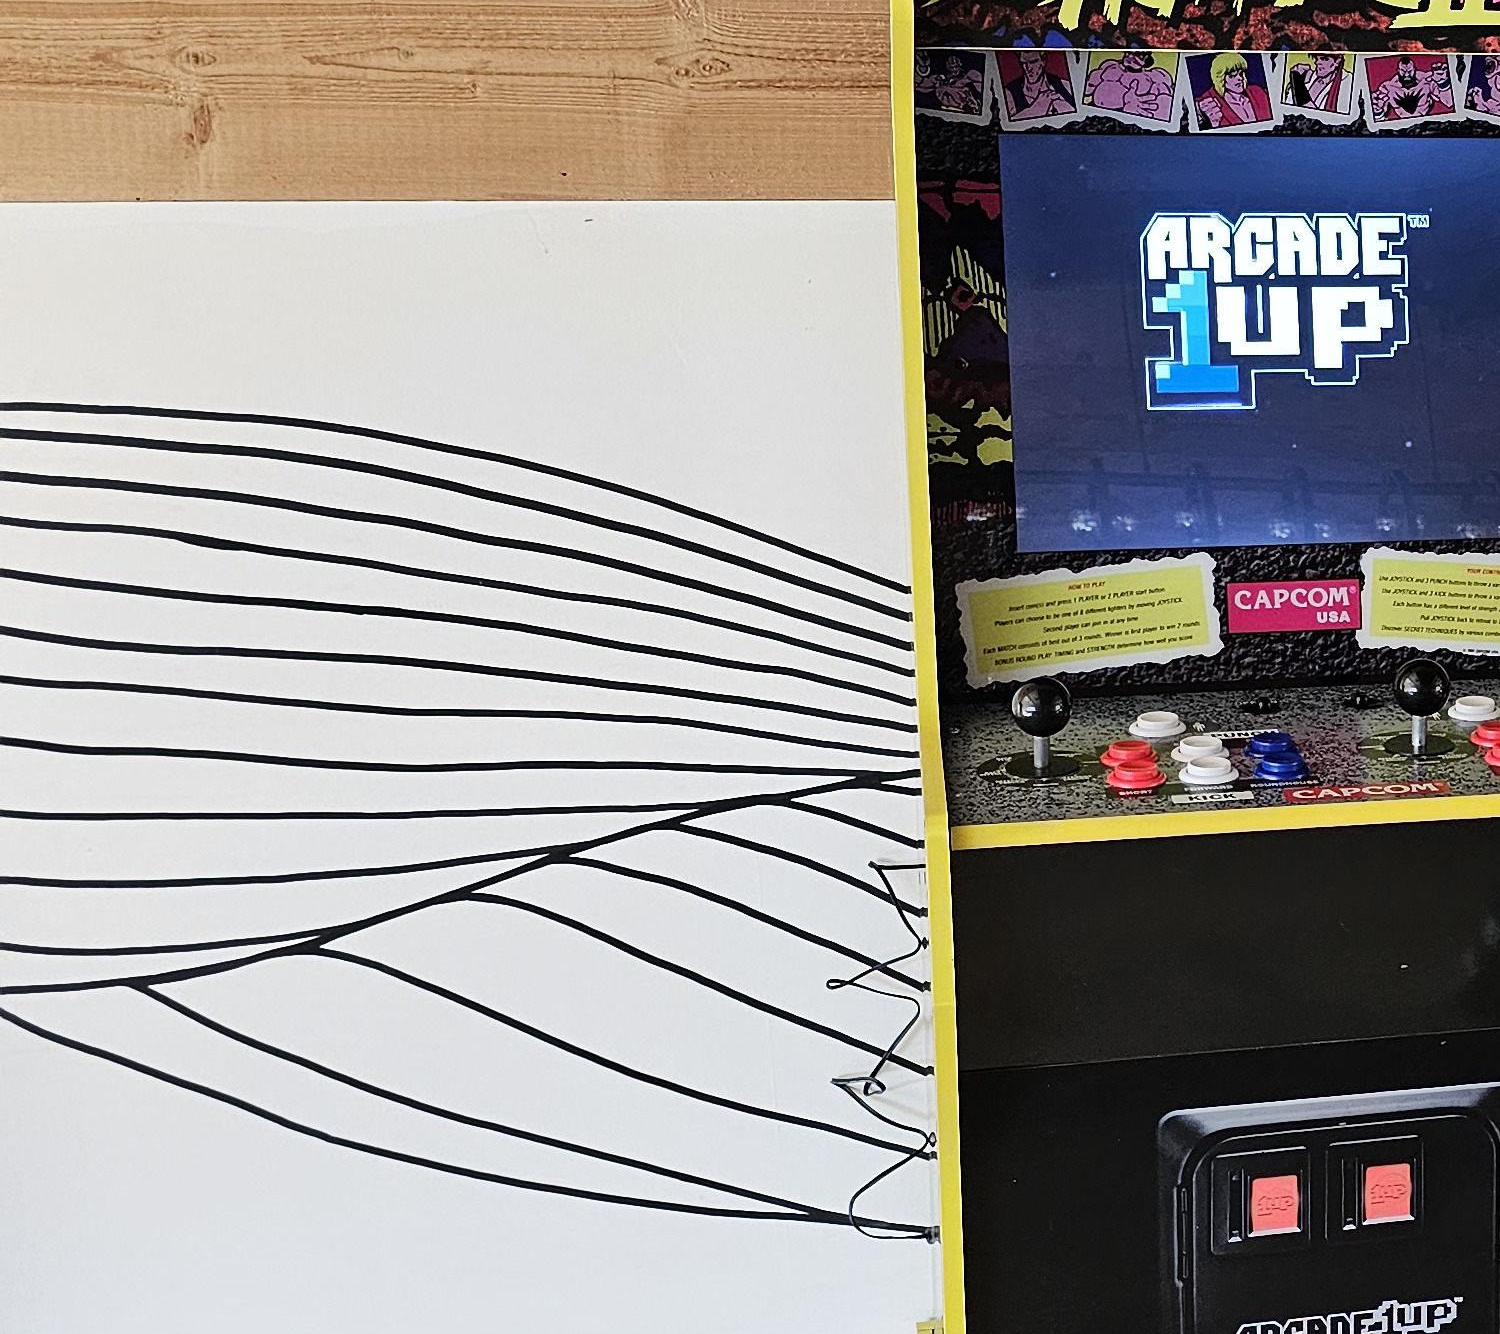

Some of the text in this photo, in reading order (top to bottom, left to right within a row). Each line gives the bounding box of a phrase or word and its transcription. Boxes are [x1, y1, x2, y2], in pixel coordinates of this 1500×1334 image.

[1147, 216, 1402, 284] ARCADE
[1151, 269, 1395, 394] 1UP
[1234, 587, 1351, 610] CAPCOM
[1316, 611, 1351, 624] USA
[1188, 793, 1236, 802] KICK
[1292, 783, 1435, 799] CAPCOM
